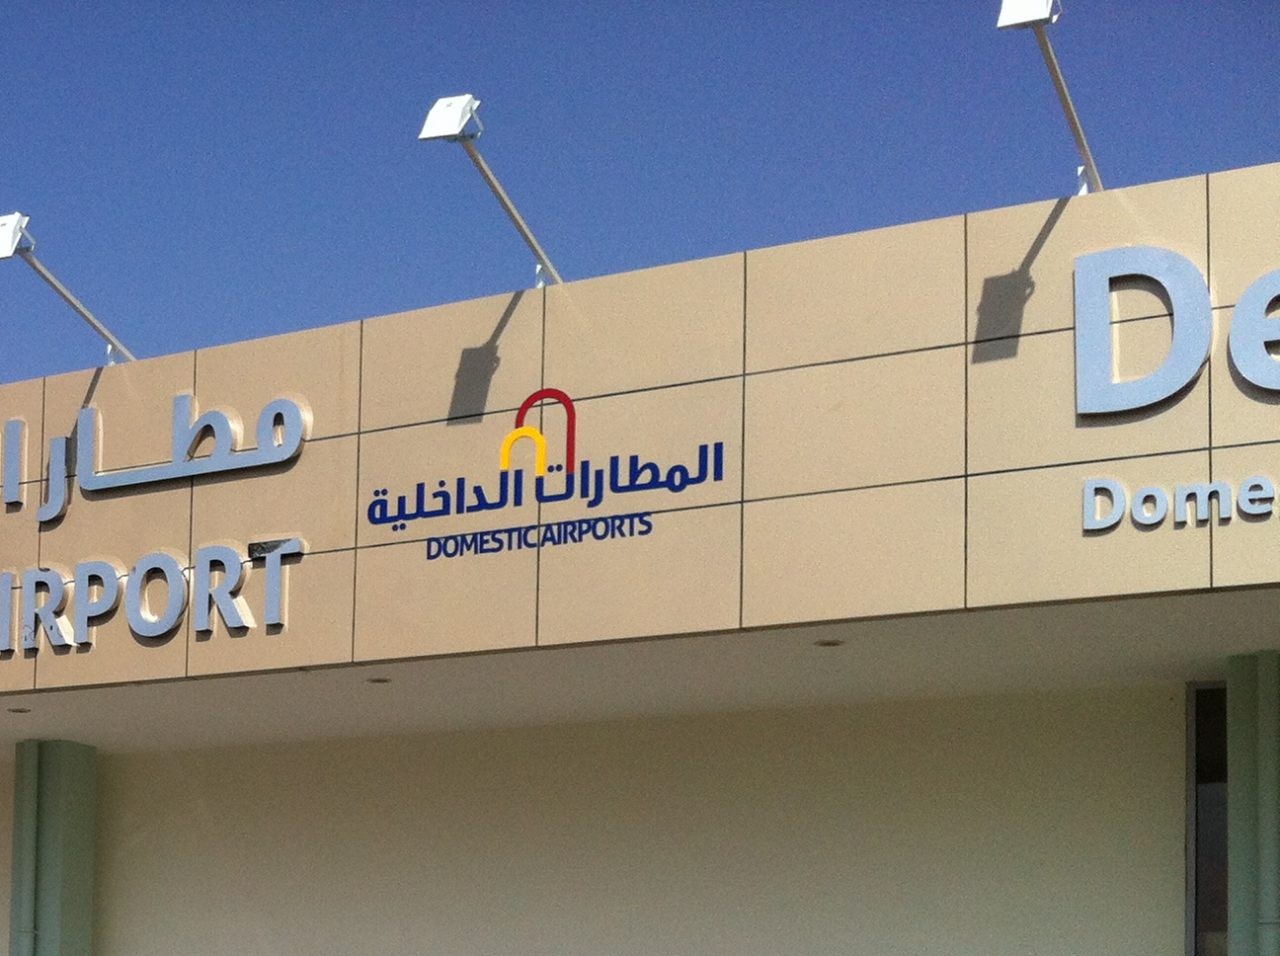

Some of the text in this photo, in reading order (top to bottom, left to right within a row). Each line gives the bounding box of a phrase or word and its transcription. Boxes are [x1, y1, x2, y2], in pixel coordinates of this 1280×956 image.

[36, 393, 309, 523] مطار
[367, 442, 724, 531] المطارات الداخلية
